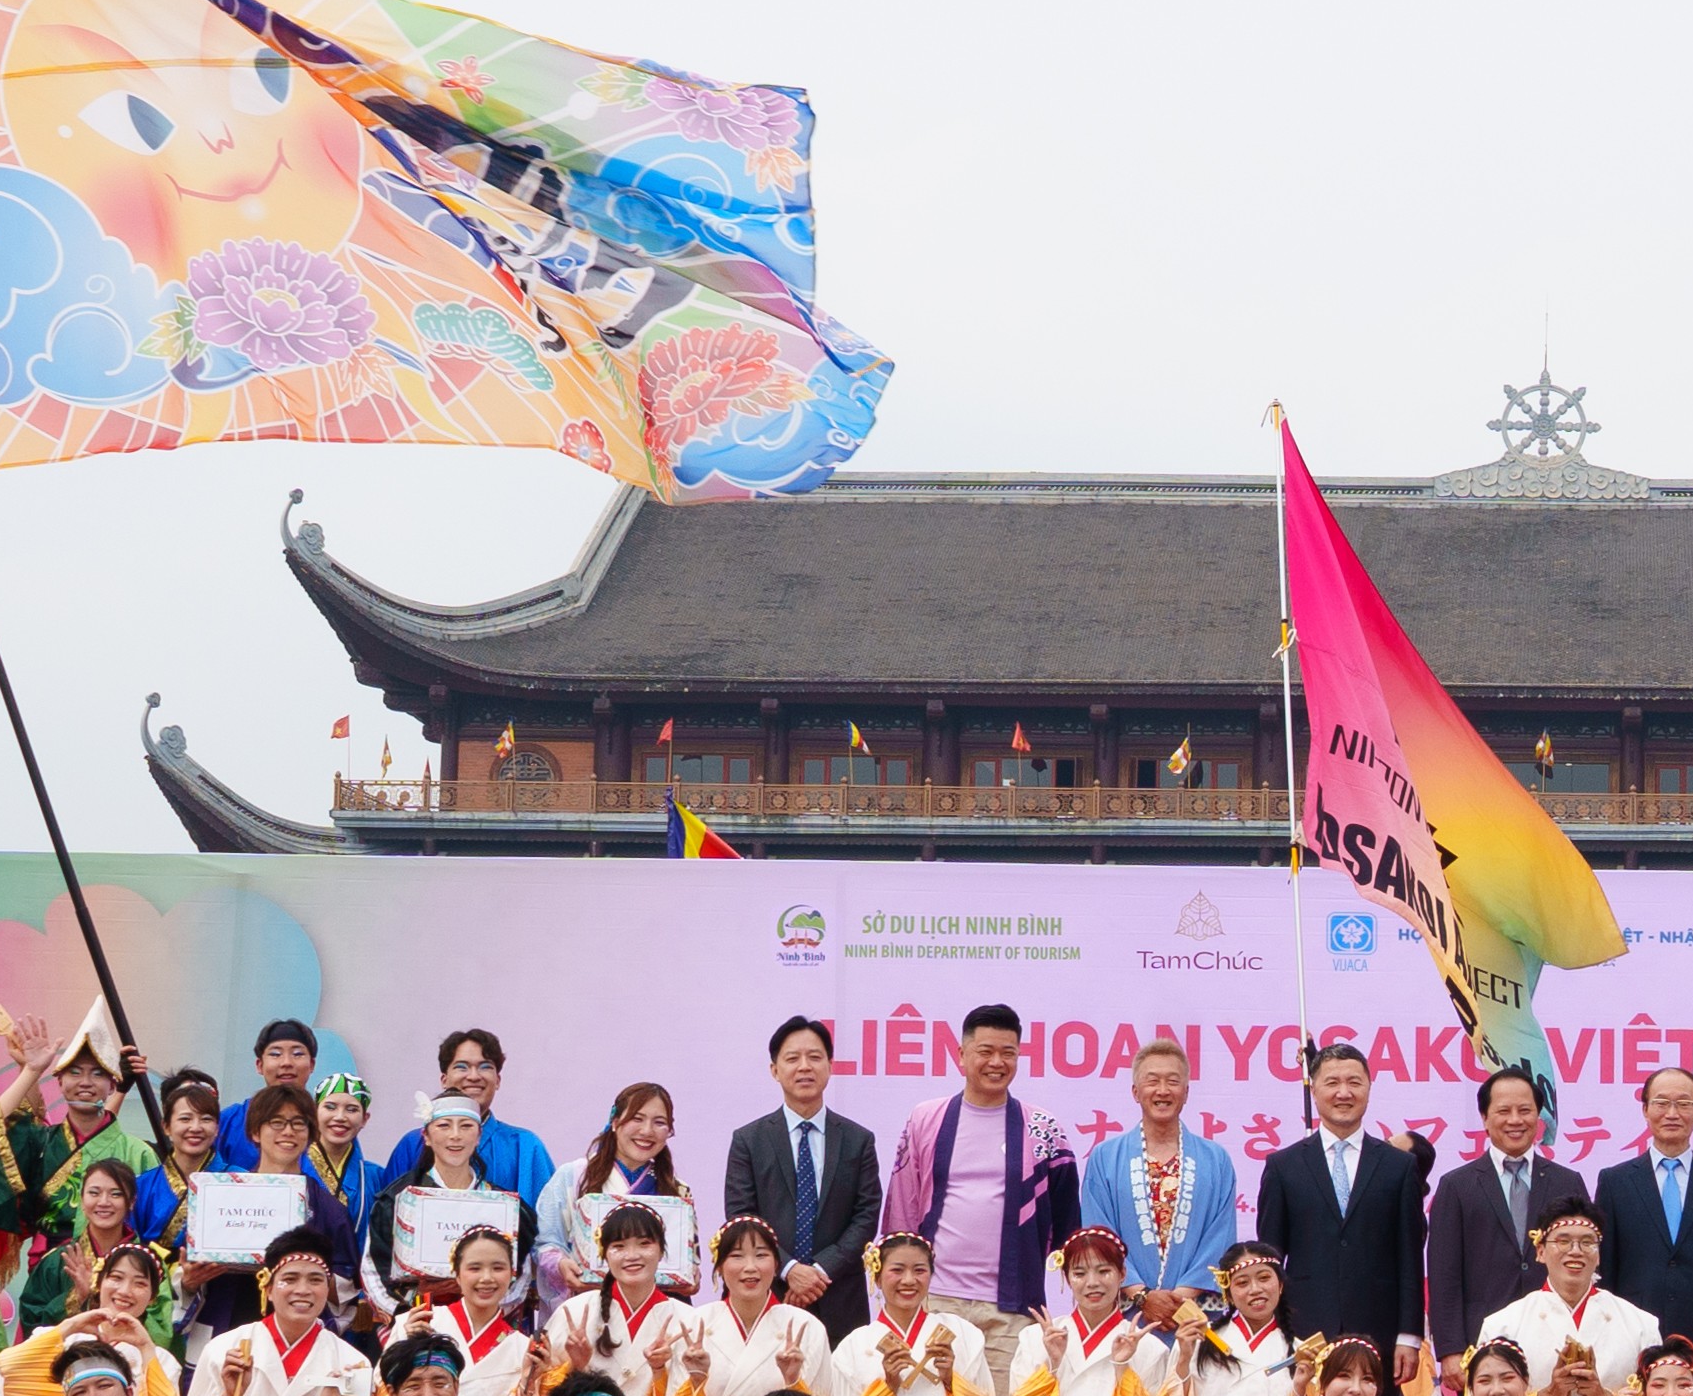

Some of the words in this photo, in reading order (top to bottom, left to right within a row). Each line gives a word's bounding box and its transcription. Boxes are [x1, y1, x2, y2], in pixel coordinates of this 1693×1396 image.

[862, 910, 885, 935] SỞ
[890, 916, 915, 935] DU
[920, 916, 960, 939] LỊCH
[967, 917, 1011, 935] NINH
[1018, 912, 1062, 936] BÌNH
[1623, 927, 1643, 946] ỆT
[844, 945, 878, 959] NINH
[881, 941, 913, 959] BÌNH
[917, 945, 1001, 960] DEPARTMENT
[1005, 946, 1021, 959] OF
[1024, 946, 1081, 960] TOURISM
[1332, 958, 1369, 972] VIJACA
[1217, 1024, 1492, 1084] YOAKO
